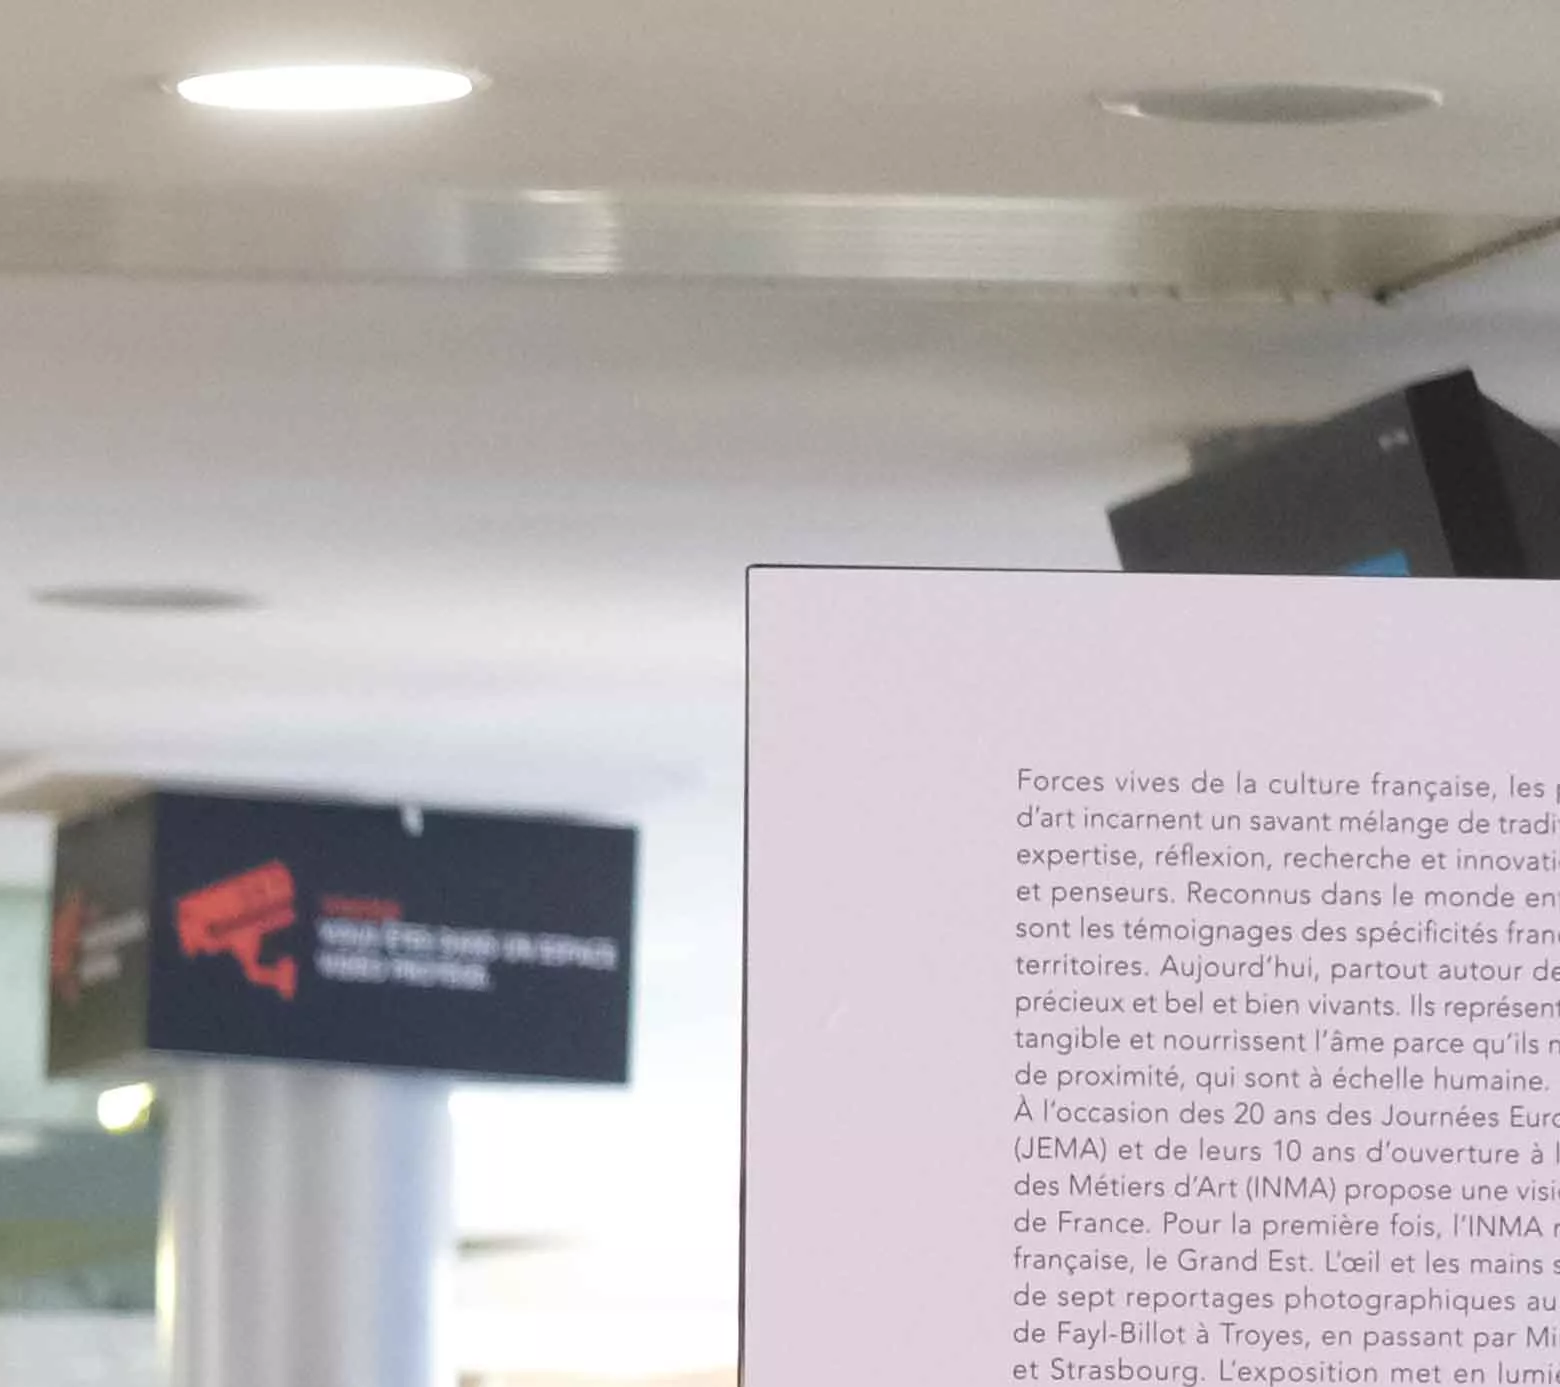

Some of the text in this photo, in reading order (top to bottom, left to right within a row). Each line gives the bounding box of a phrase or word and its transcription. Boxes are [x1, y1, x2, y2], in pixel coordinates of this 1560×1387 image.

[1018, 768, 1545, 803] Forces vives de la culture française, les
[1017, 880, 1515, 909] et penseurs. Reconnus dans le monde
[1014, 1094, 1499, 1128] À l'occasion des 20 ans des Journées
[1014, 1208, 1543, 1241] de France. Pour la première fois, l'INMA
